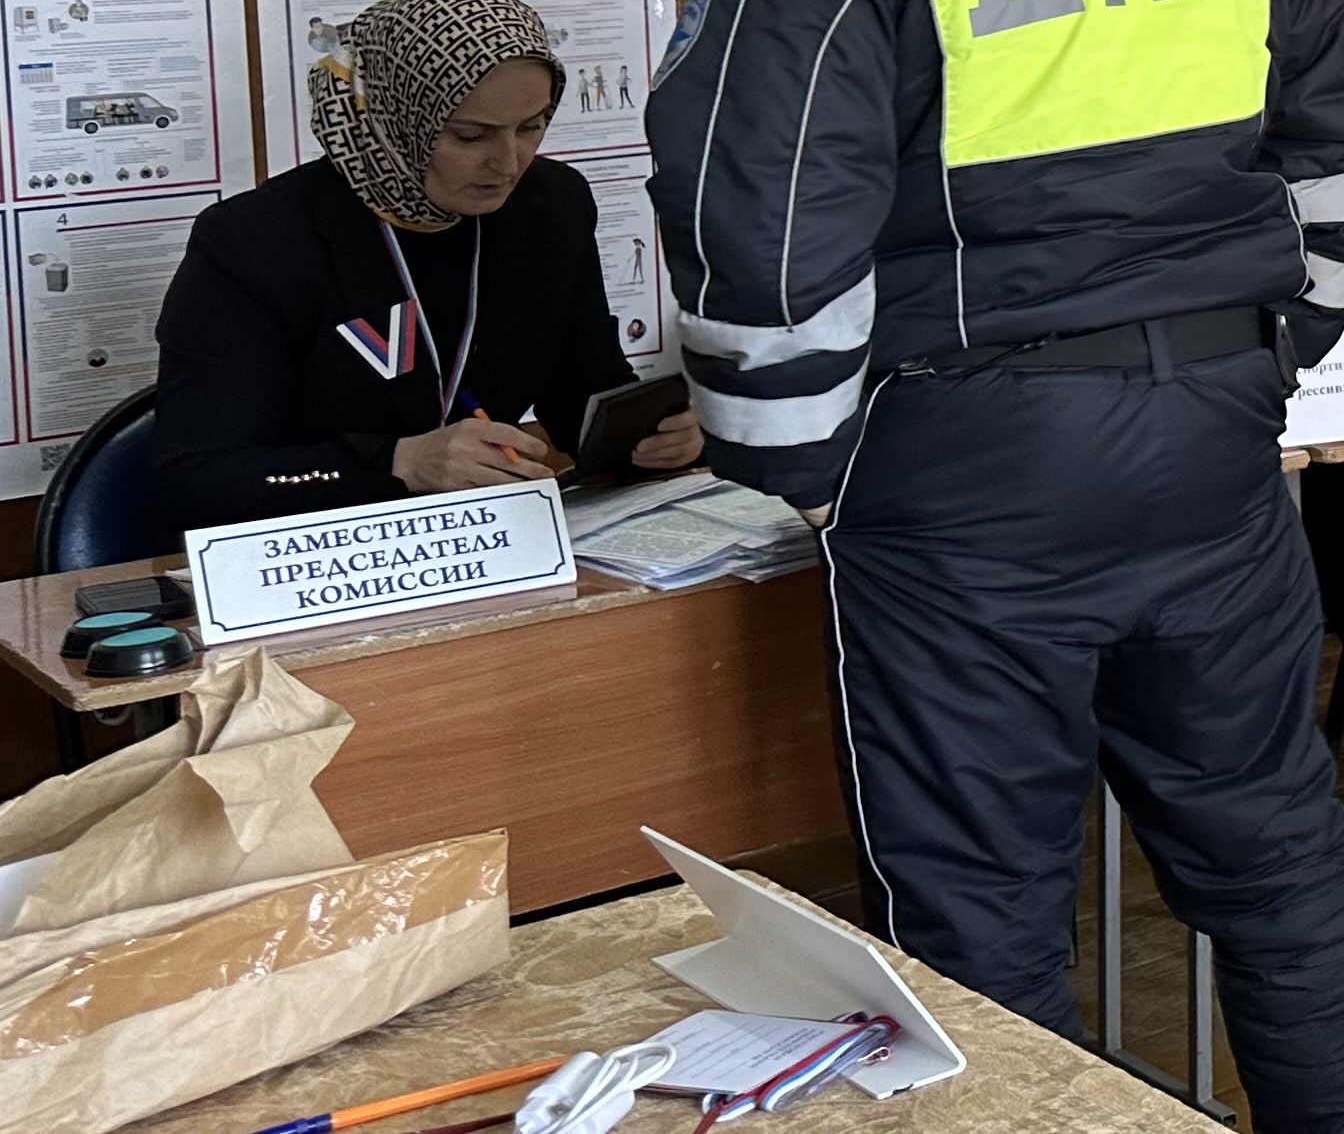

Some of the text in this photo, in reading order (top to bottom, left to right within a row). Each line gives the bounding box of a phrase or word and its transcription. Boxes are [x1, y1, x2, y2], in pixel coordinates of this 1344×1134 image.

[56, 212, 69, 226] 4
[259, 529, 512, 587] ПРЕДСЕДАТЕЛЯ
[263, 506, 497, 559] ЗАМЕСТИТЕЛЬ
[297, 560, 488, 609] КОМИССИИ
